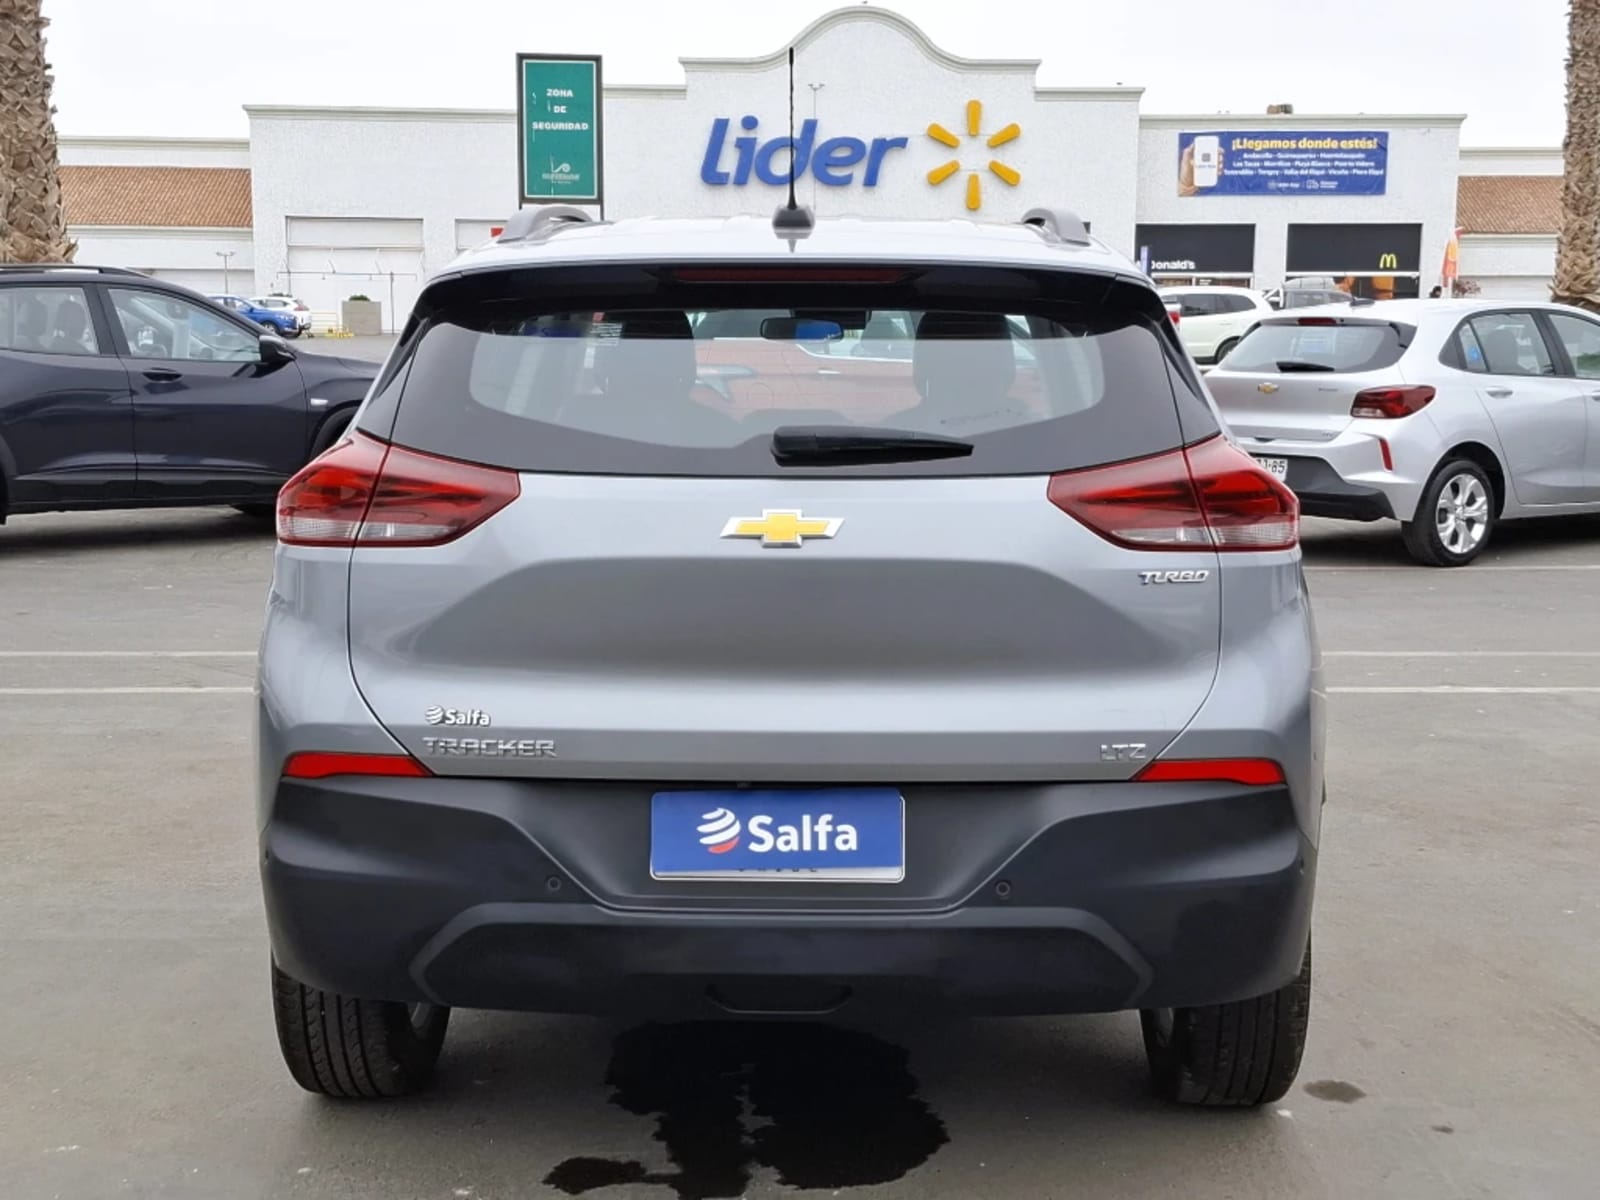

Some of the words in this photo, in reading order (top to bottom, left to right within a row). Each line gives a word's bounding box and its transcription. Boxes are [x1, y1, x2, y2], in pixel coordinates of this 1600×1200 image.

[546, 88, 574, 98] ZONA
[553, 105, 567, 114] DE
[532, 121, 589, 131] SEGURIDAD
[1232, 137, 1296, 151] ¡Llegamos
[1298, 136, 1338, 149] donde
[1139, 570, 1210, 584] TURBO
[445, 709, 491, 726] Salfa
[422, 736, 557, 758] TRACKER
[1100, 743, 1147, 760] LTZ
[748, 813, 858, 853] Salfa
